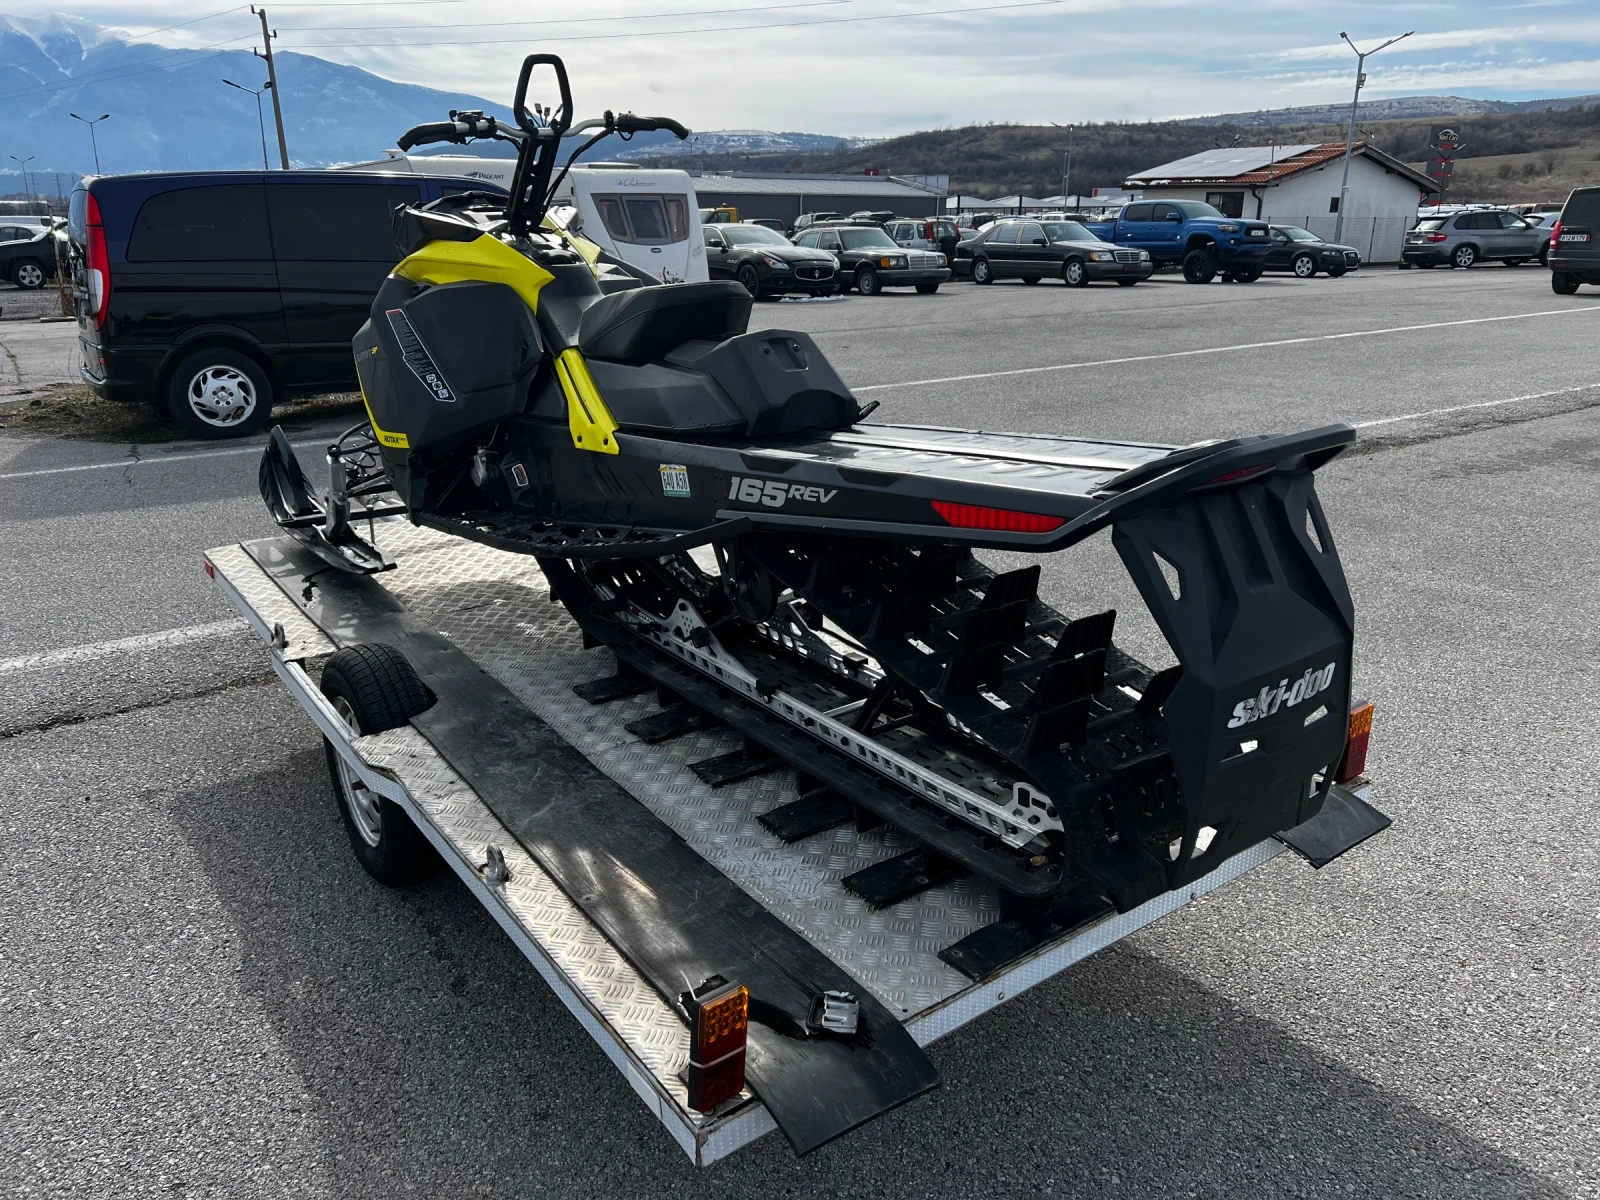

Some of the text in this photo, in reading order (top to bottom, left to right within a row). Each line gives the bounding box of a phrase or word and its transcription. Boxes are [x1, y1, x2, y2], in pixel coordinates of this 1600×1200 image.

[383, 434, 400, 445] ROTAX
[728, 476, 838, 508] 165 REV
